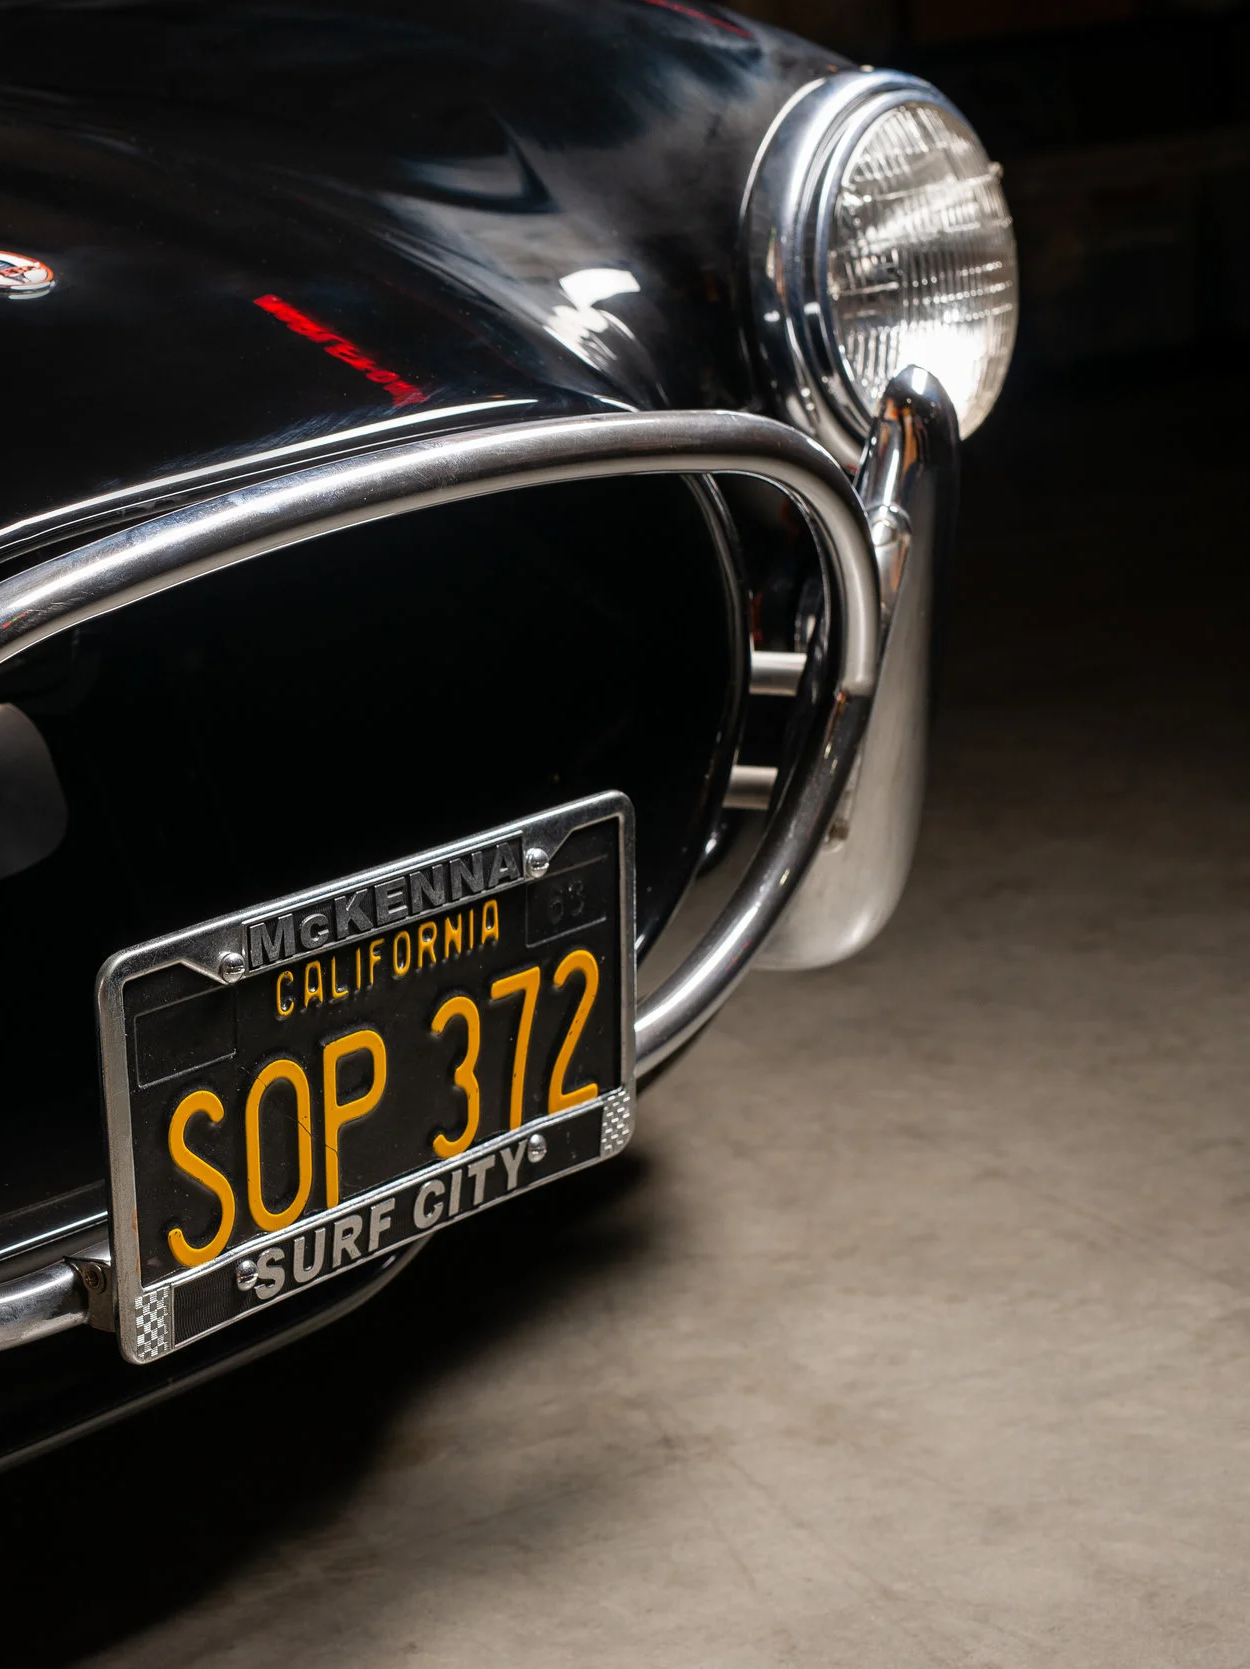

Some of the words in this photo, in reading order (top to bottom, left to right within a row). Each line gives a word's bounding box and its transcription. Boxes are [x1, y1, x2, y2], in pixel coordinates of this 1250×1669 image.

[276, 899, 500, 1018] CALIFORNIA
[167, 1029, 388, 1269] SOP
[430, 948, 600, 1160] 372
[253, 1197, 396, 1300] SURF
[413, 1139, 529, 1231] CITY
